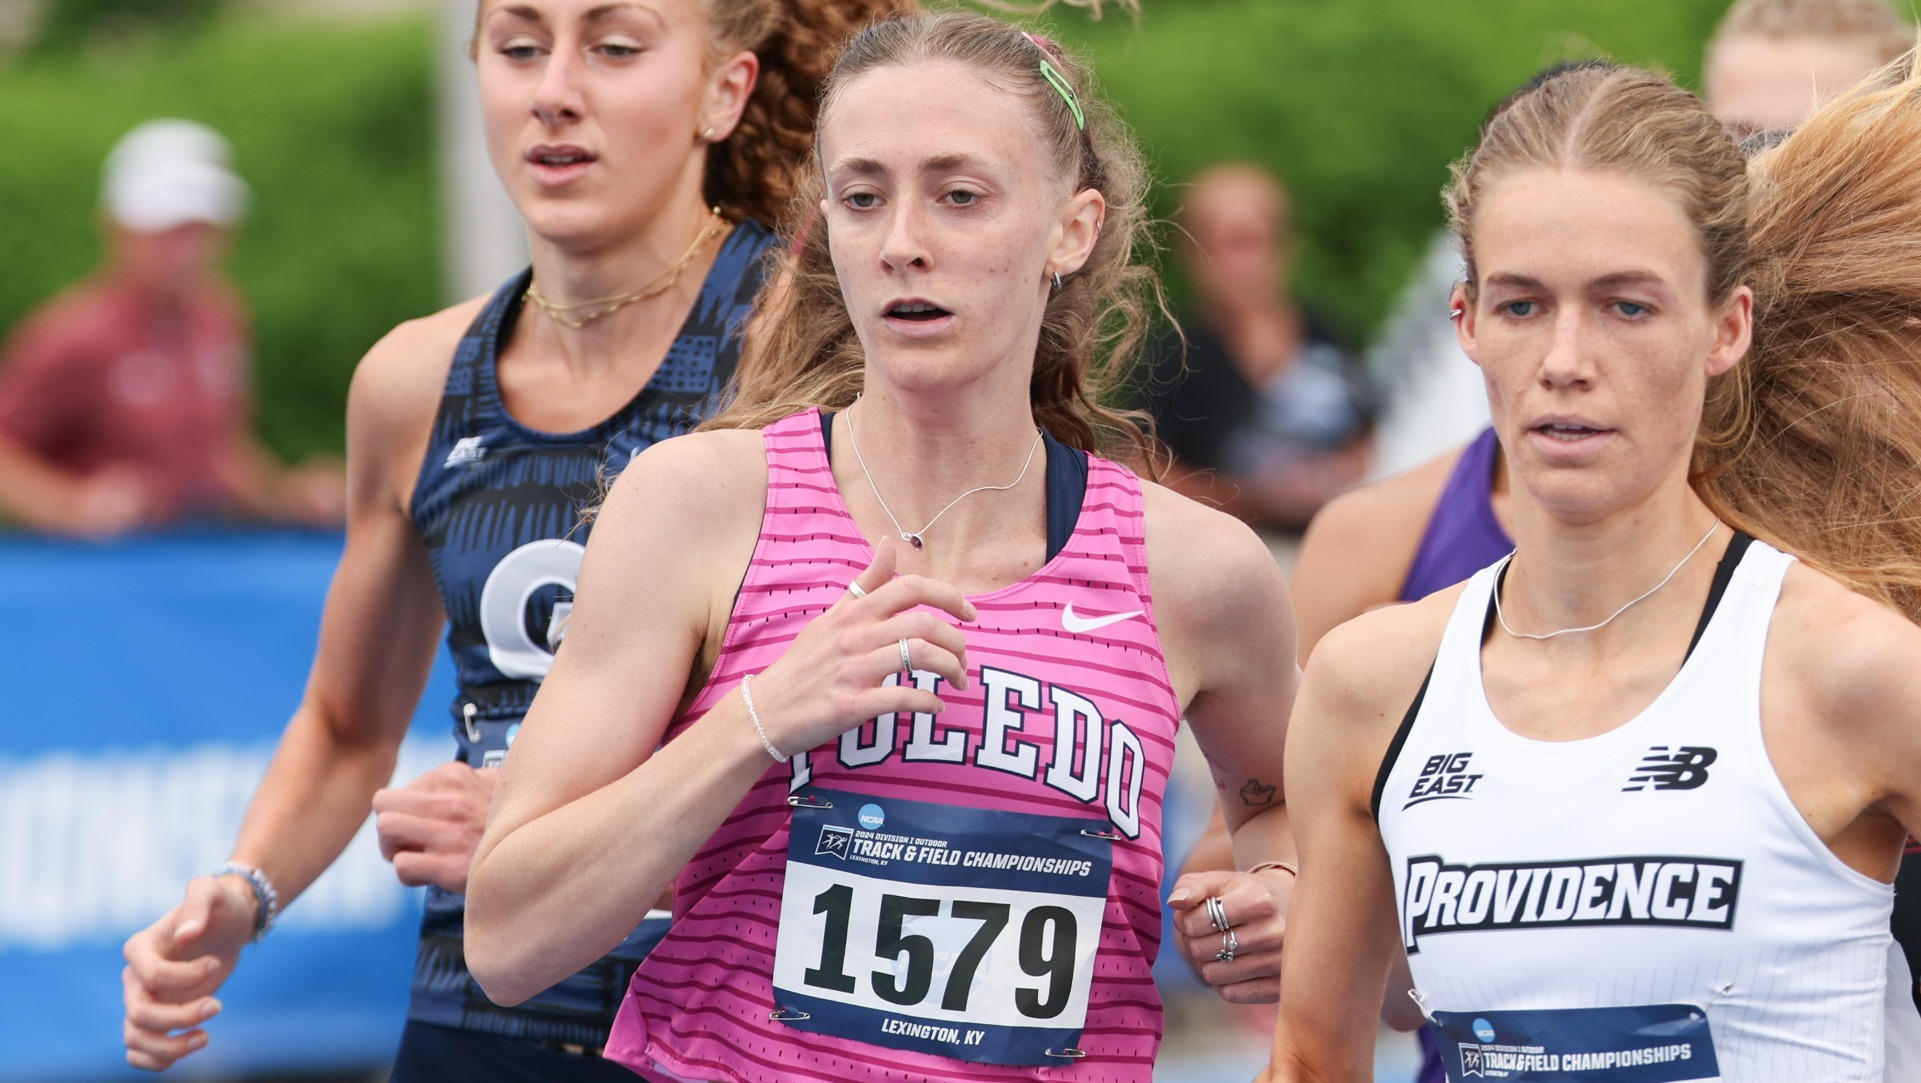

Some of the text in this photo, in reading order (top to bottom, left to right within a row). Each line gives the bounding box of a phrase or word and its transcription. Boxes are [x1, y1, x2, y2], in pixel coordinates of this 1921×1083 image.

[1419, 752, 1474, 777] BIG
[1408, 774, 1484, 799] EAST
[860, 814, 884, 825] NCAA
[855, 830, 948, 848] 2024 DIVISION I OUTDOOR
[850, 854, 880, 866] LEXINGTON,
[853, 838, 1092, 877] TRACK & FIELD CHAMPIONSHIPS
[1404, 857, 1738, 951] PROVIDENCE
[803, 883, 1078, 1019] 1579
[881, 1018, 985, 1046] LEXINGTON, KY
[1483, 1043, 1692, 1072] TRACK & FIELD CHAMPIONSHIPS
